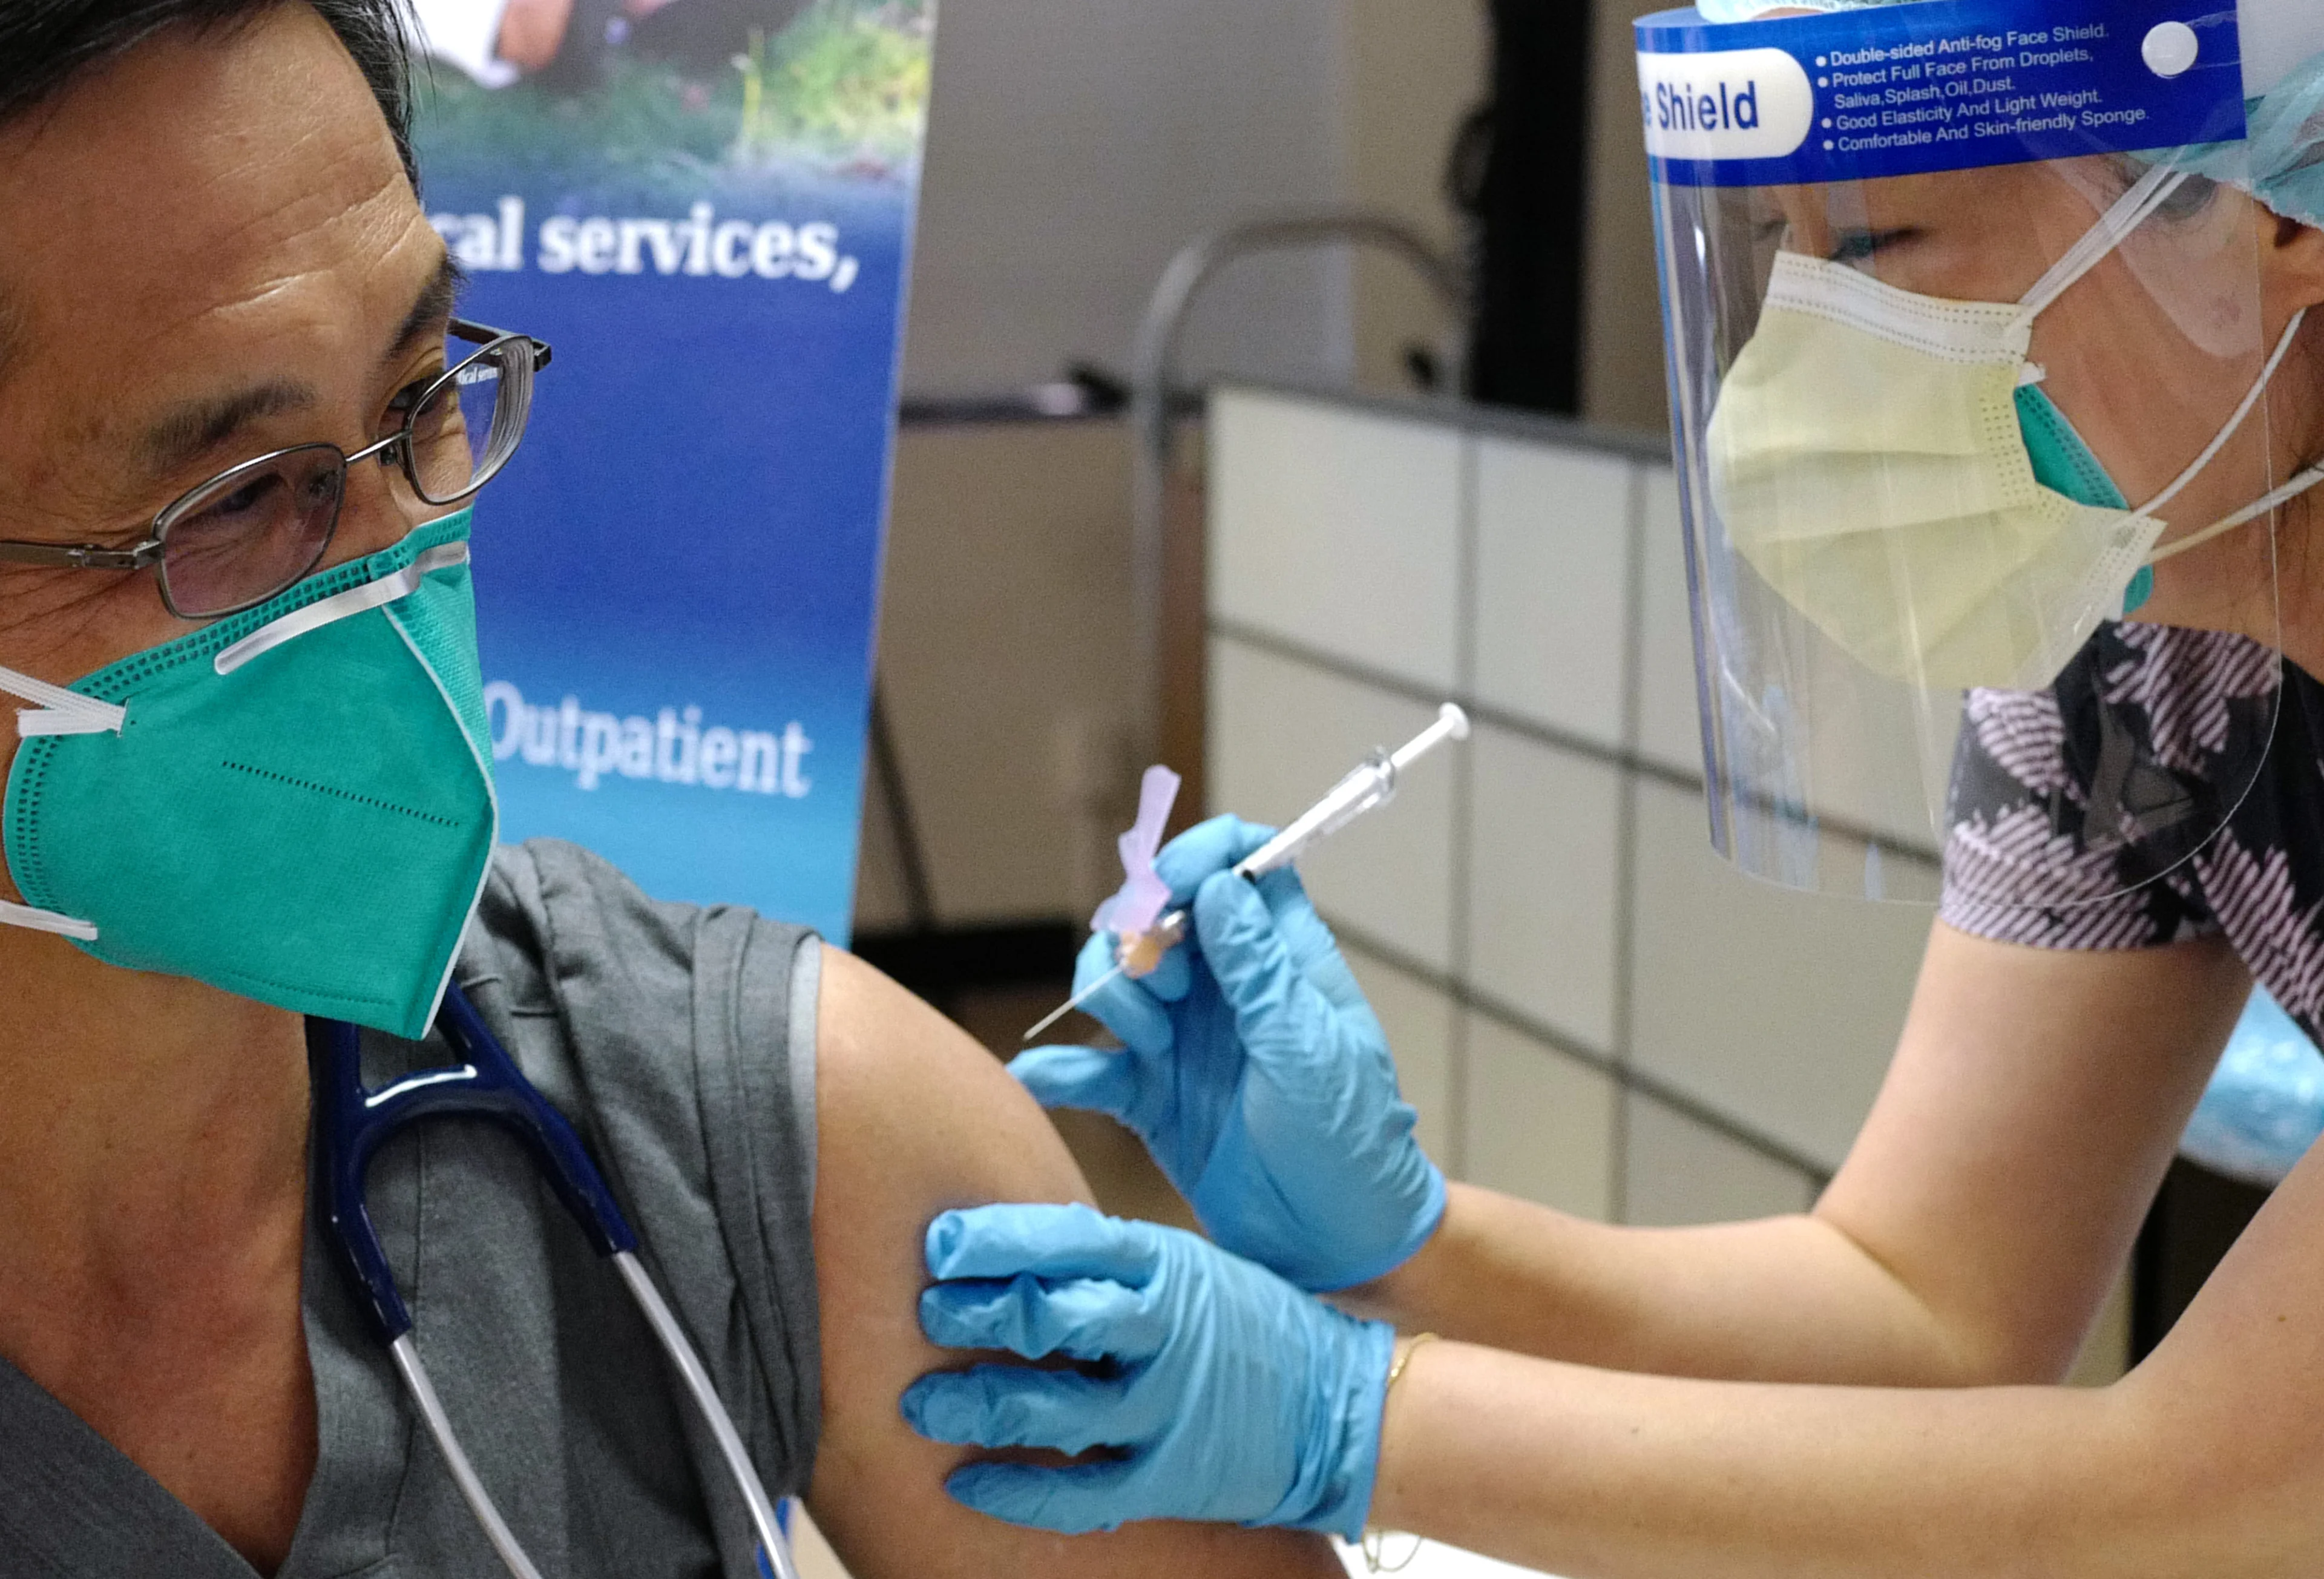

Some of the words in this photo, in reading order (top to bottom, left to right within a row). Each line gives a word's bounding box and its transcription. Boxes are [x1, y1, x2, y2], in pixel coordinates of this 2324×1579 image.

[1830, 40, 1934, 67] Double-sided
[1938, 34, 2002, 53] Anti-fog
[2006, 31, 2048, 47] Face
[2052, 24, 2109, 42] Shield.
[1833, 69, 1886, 88] Protect
[1891, 64, 1920, 81] Full
[1925, 57, 1966, 77] Face
[1971, 56, 2015, 72] From
[2019, 47, 2093, 67] Droplets,
[1656, 80, 1759, 131] Shield
[1836, 113, 1877, 130] Good
[1882, 106, 1952, 126] Elasticity
[1957, 100, 1990, 117] And
[1995, 95, 2036, 115] Light
[2039, 89, 2102, 108] Weight.
[1838, 129, 1932, 151] Comfortable
[1936, 125, 1969, 142] And
[1974, 113, 2076, 137] Skin-friendly
[2081, 108, 2150, 127] Sponge.
[537, 201, 858, 293] services,
[484, 680, 813, 799] Outpatient
